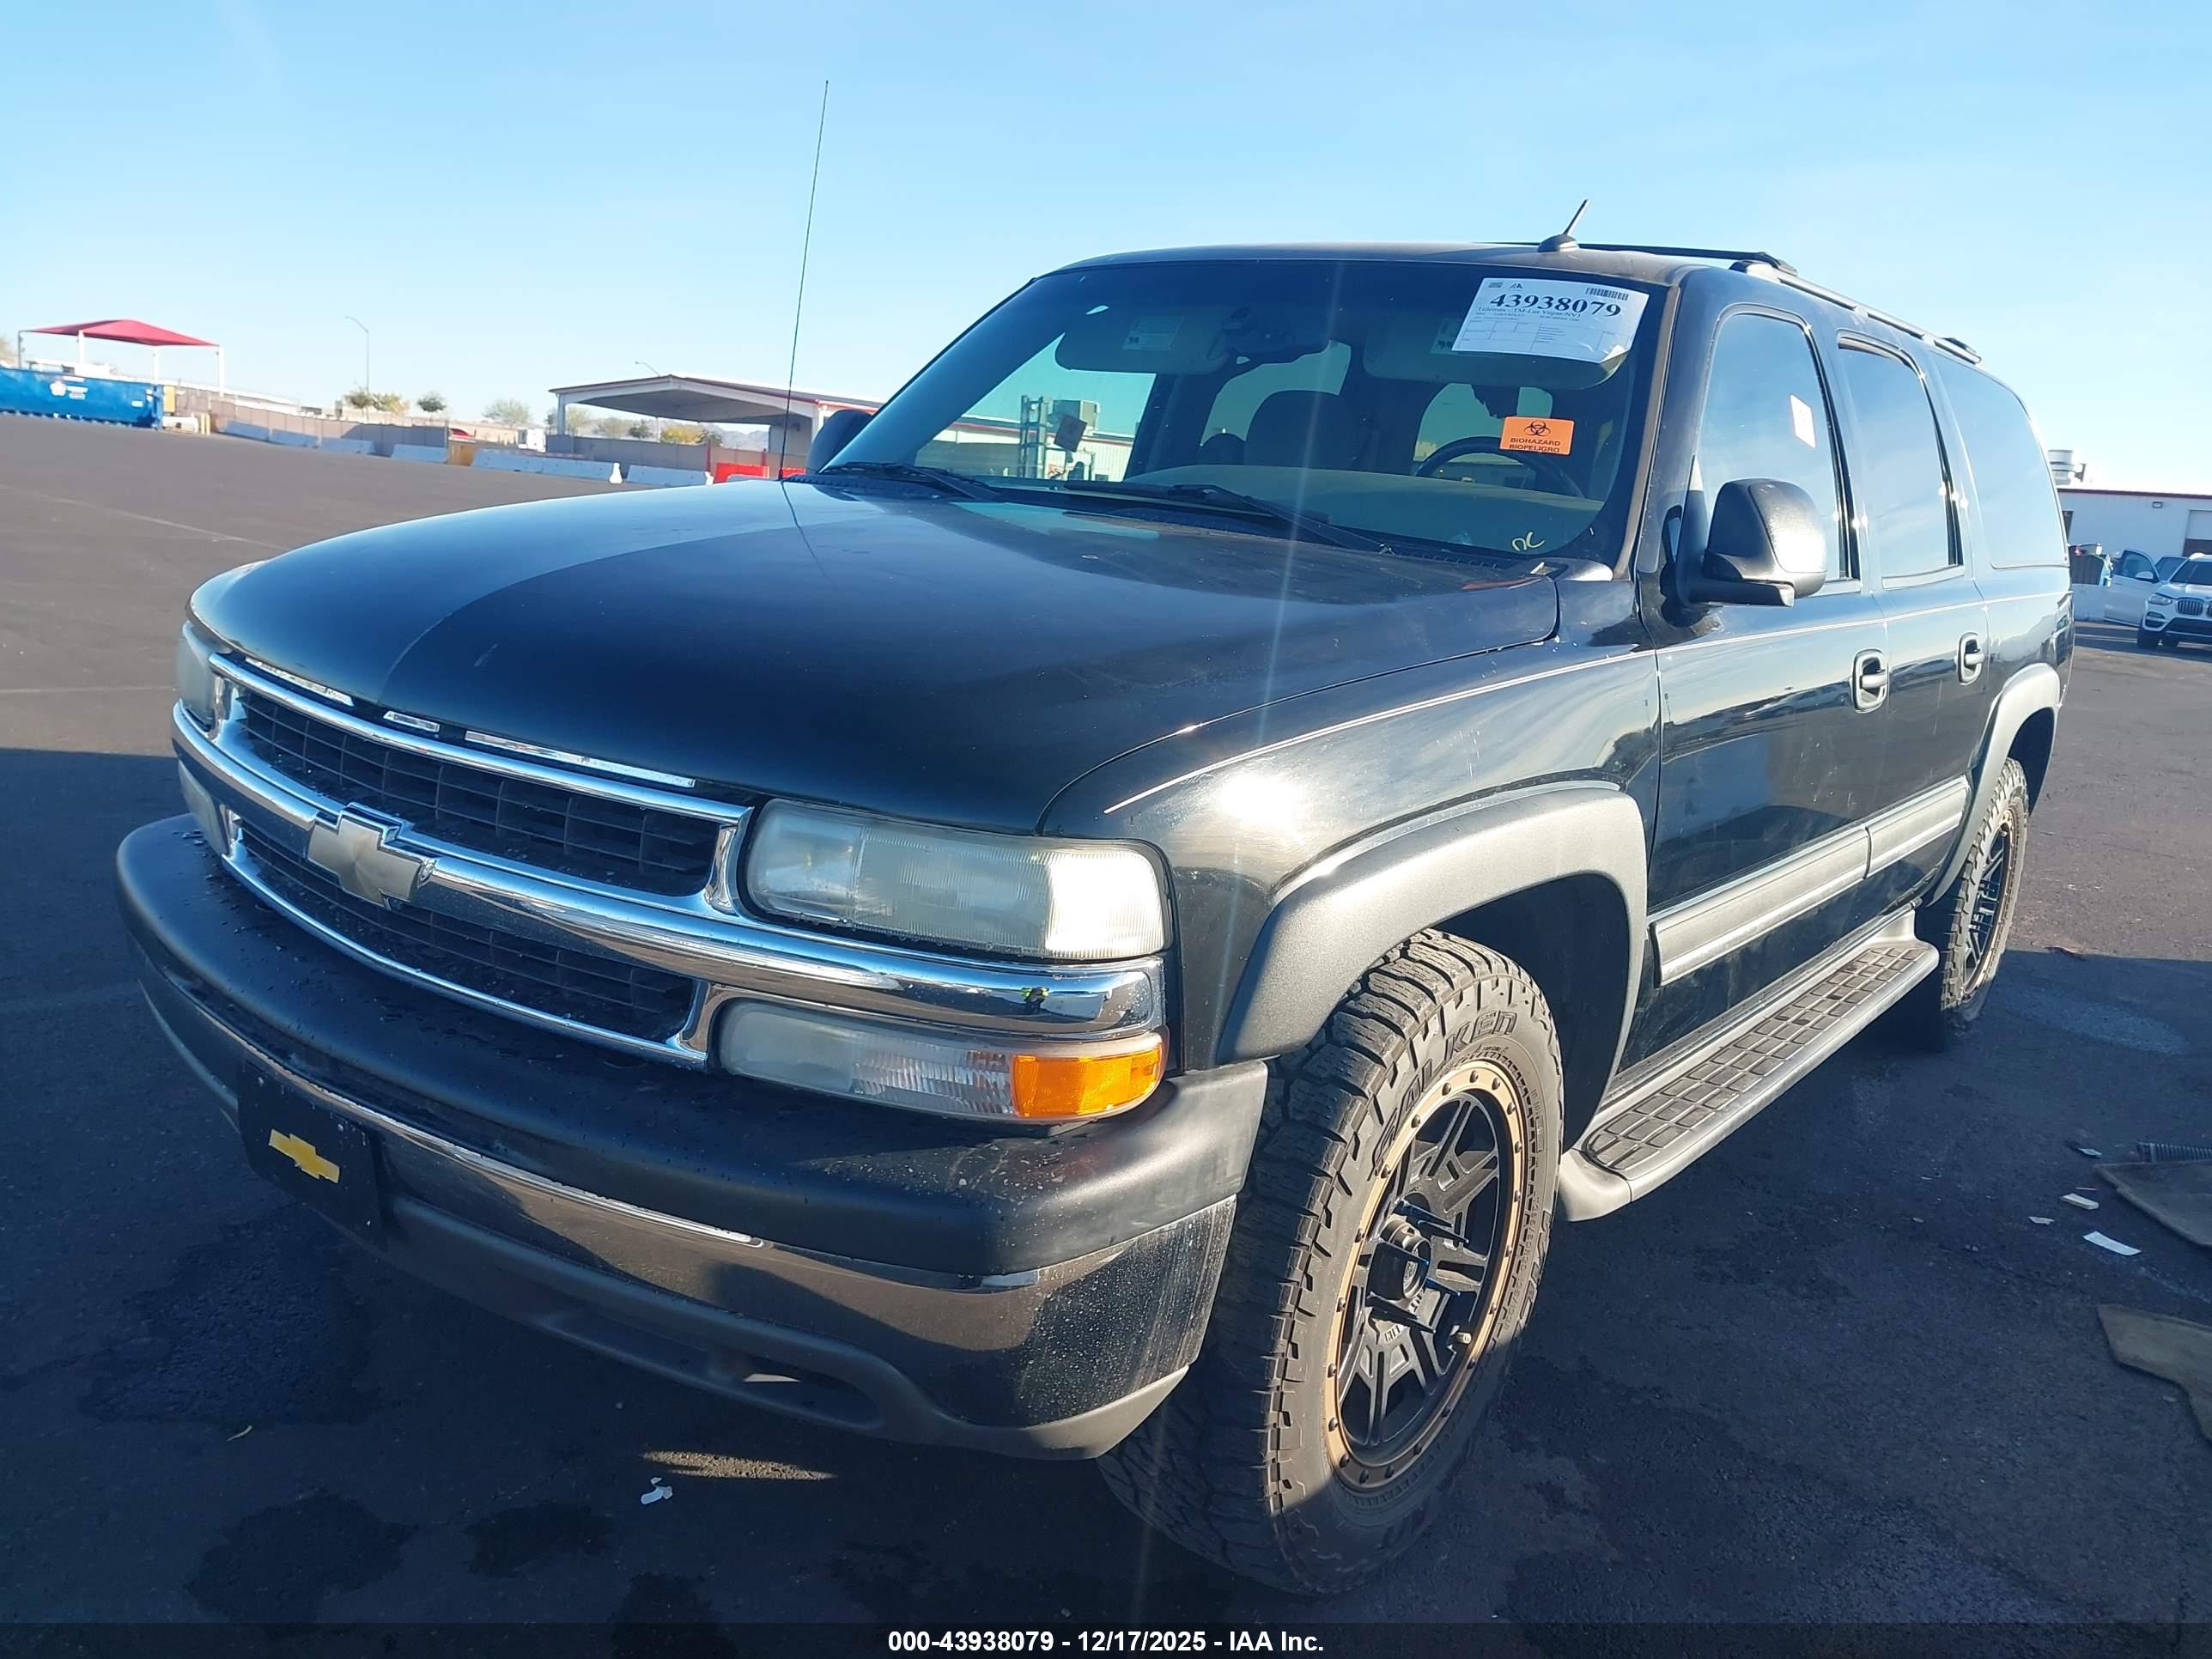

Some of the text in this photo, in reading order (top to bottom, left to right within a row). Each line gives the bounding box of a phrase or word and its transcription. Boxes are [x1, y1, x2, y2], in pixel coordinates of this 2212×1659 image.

[1490, 293, 1622, 317] 43938079
[1510, 437, 1561, 447] BIOHAZARD
[1508, 444, 1560, 453] BIOPELIGRO
